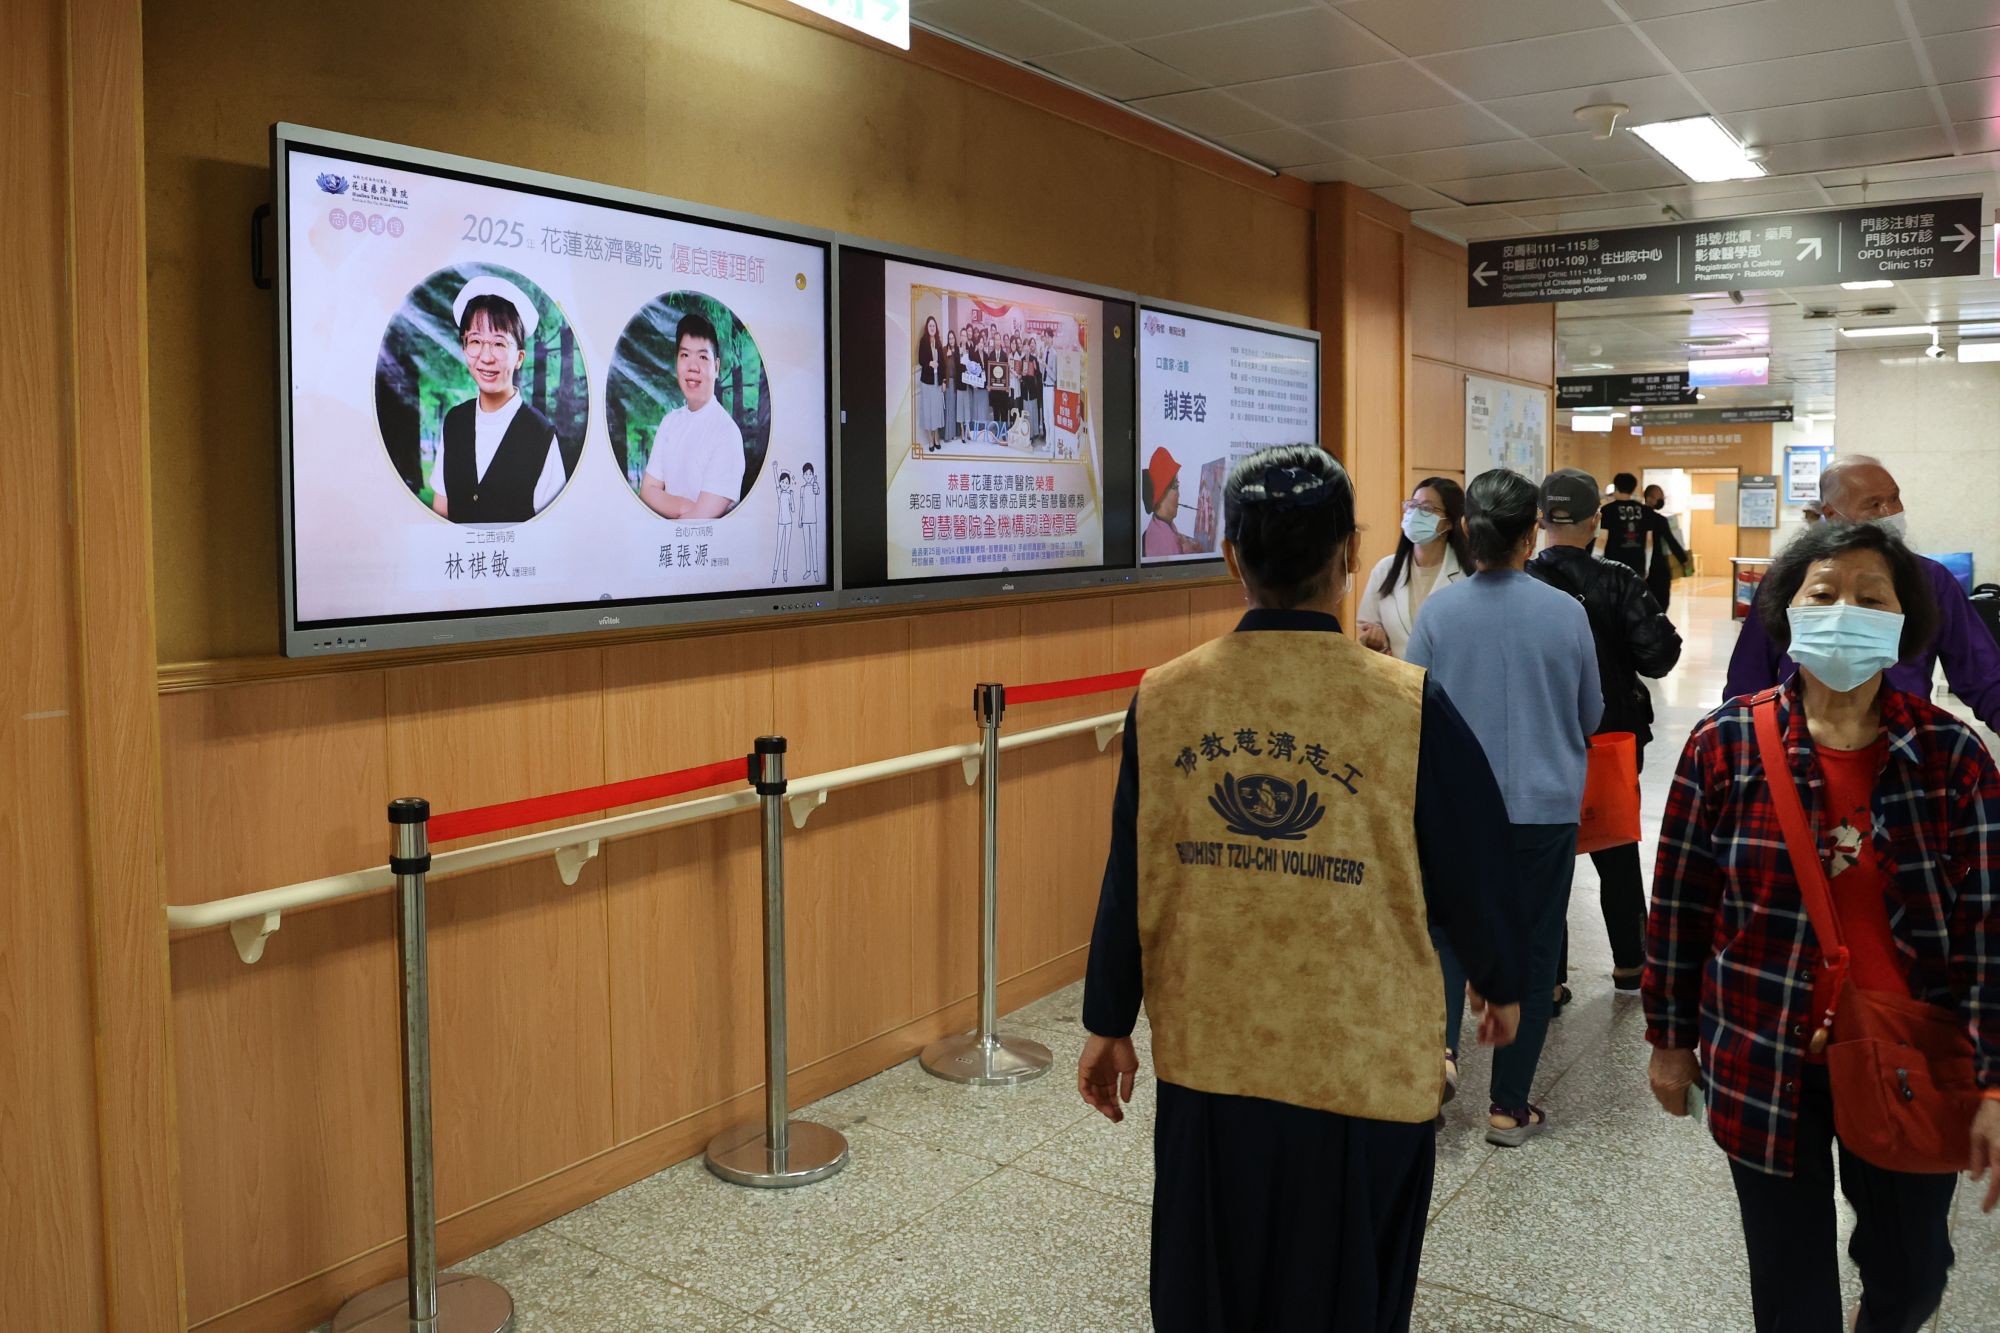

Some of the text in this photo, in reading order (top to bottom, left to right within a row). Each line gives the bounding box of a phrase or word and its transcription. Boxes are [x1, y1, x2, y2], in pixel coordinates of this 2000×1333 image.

[1860, 213, 1935, 232] 門診注射室
[1865, 229, 1933, 247] 門診157診
[541, 226, 663, 271] 花蓮慈濟醫院
[671, 242, 766, 285] 優良護理師
[1695, 244, 1762, 262] 影像醫學部
[1858, 246, 1934, 260] OPD Injection
[1695, 259, 1783, 273] Registration & Cashier
[1879, 259, 1934, 271] Clinic 157
[1544, 280, 1552, 288] of
[1552, 277, 1582, 286] Chinese
[1583, 275, 1616, 284] Medicine
[1617, 273, 1647, 283] 101-109
[1695, 272, 1735, 281] Pharmacy
[1744, 269, 1785, 278] Radiology
[1540, 288, 1546, 296] &
[1547, 286, 1583, 296] Discharge
[1583, 285, 1608, 294] Center
[1164, 389, 1207, 423] 謝美容
[948, 473, 1055, 491] 恭喜花蓮慈濟醫院榮獲
[910, 493, 942, 510] 第25屆
[1617, 505, 1642, 521] 503
[921, 514, 1078, 540] 智慧醫院全機構認證標章
[659, 543, 710, 568] 羅張源
[445, 550, 512, 580] 林祺敏
[1175, 728, 1364, 794] 佛教慈濟志工
[1227, 844, 1277, 872] TZU-CHI
[1282, 850, 1365, 886] VOLUNTEERS
